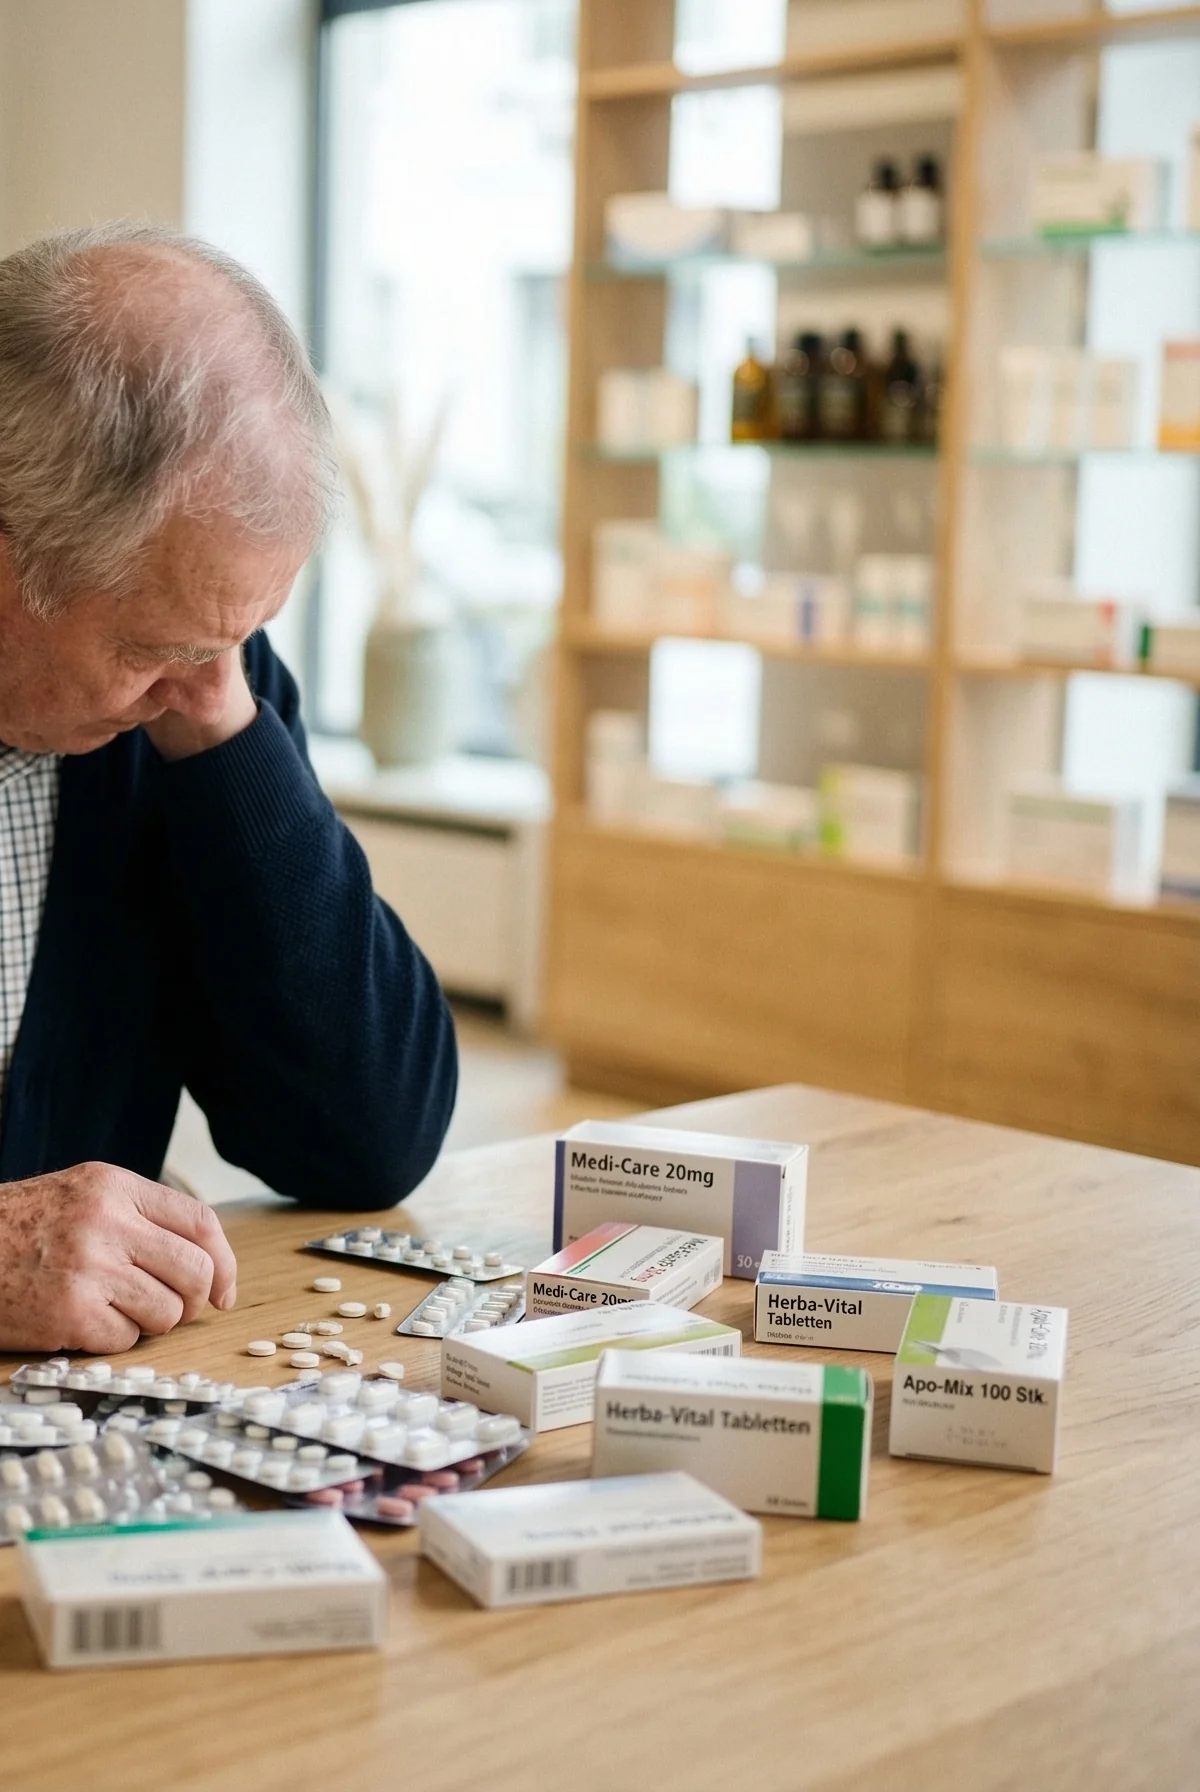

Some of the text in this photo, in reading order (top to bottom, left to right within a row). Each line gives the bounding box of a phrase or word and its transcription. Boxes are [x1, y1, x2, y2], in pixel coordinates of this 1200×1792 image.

[571, 1152, 660, 1178] Medi-Care
[666, 1163, 714, 1188] 20mg
[533, 1282, 597, 1303] Medi-Care
[768, 1294, 862, 1315] Herba-Vital
[767, 1312, 832, 1330] Tabletten
[903, 1374, 974, 1397] Apo-Mix
[981, 1382, 1011, 1401] 100
[606, 1401, 714, 1427] Herba-Vital
[721, 1411, 811, 1436] Tabletten
